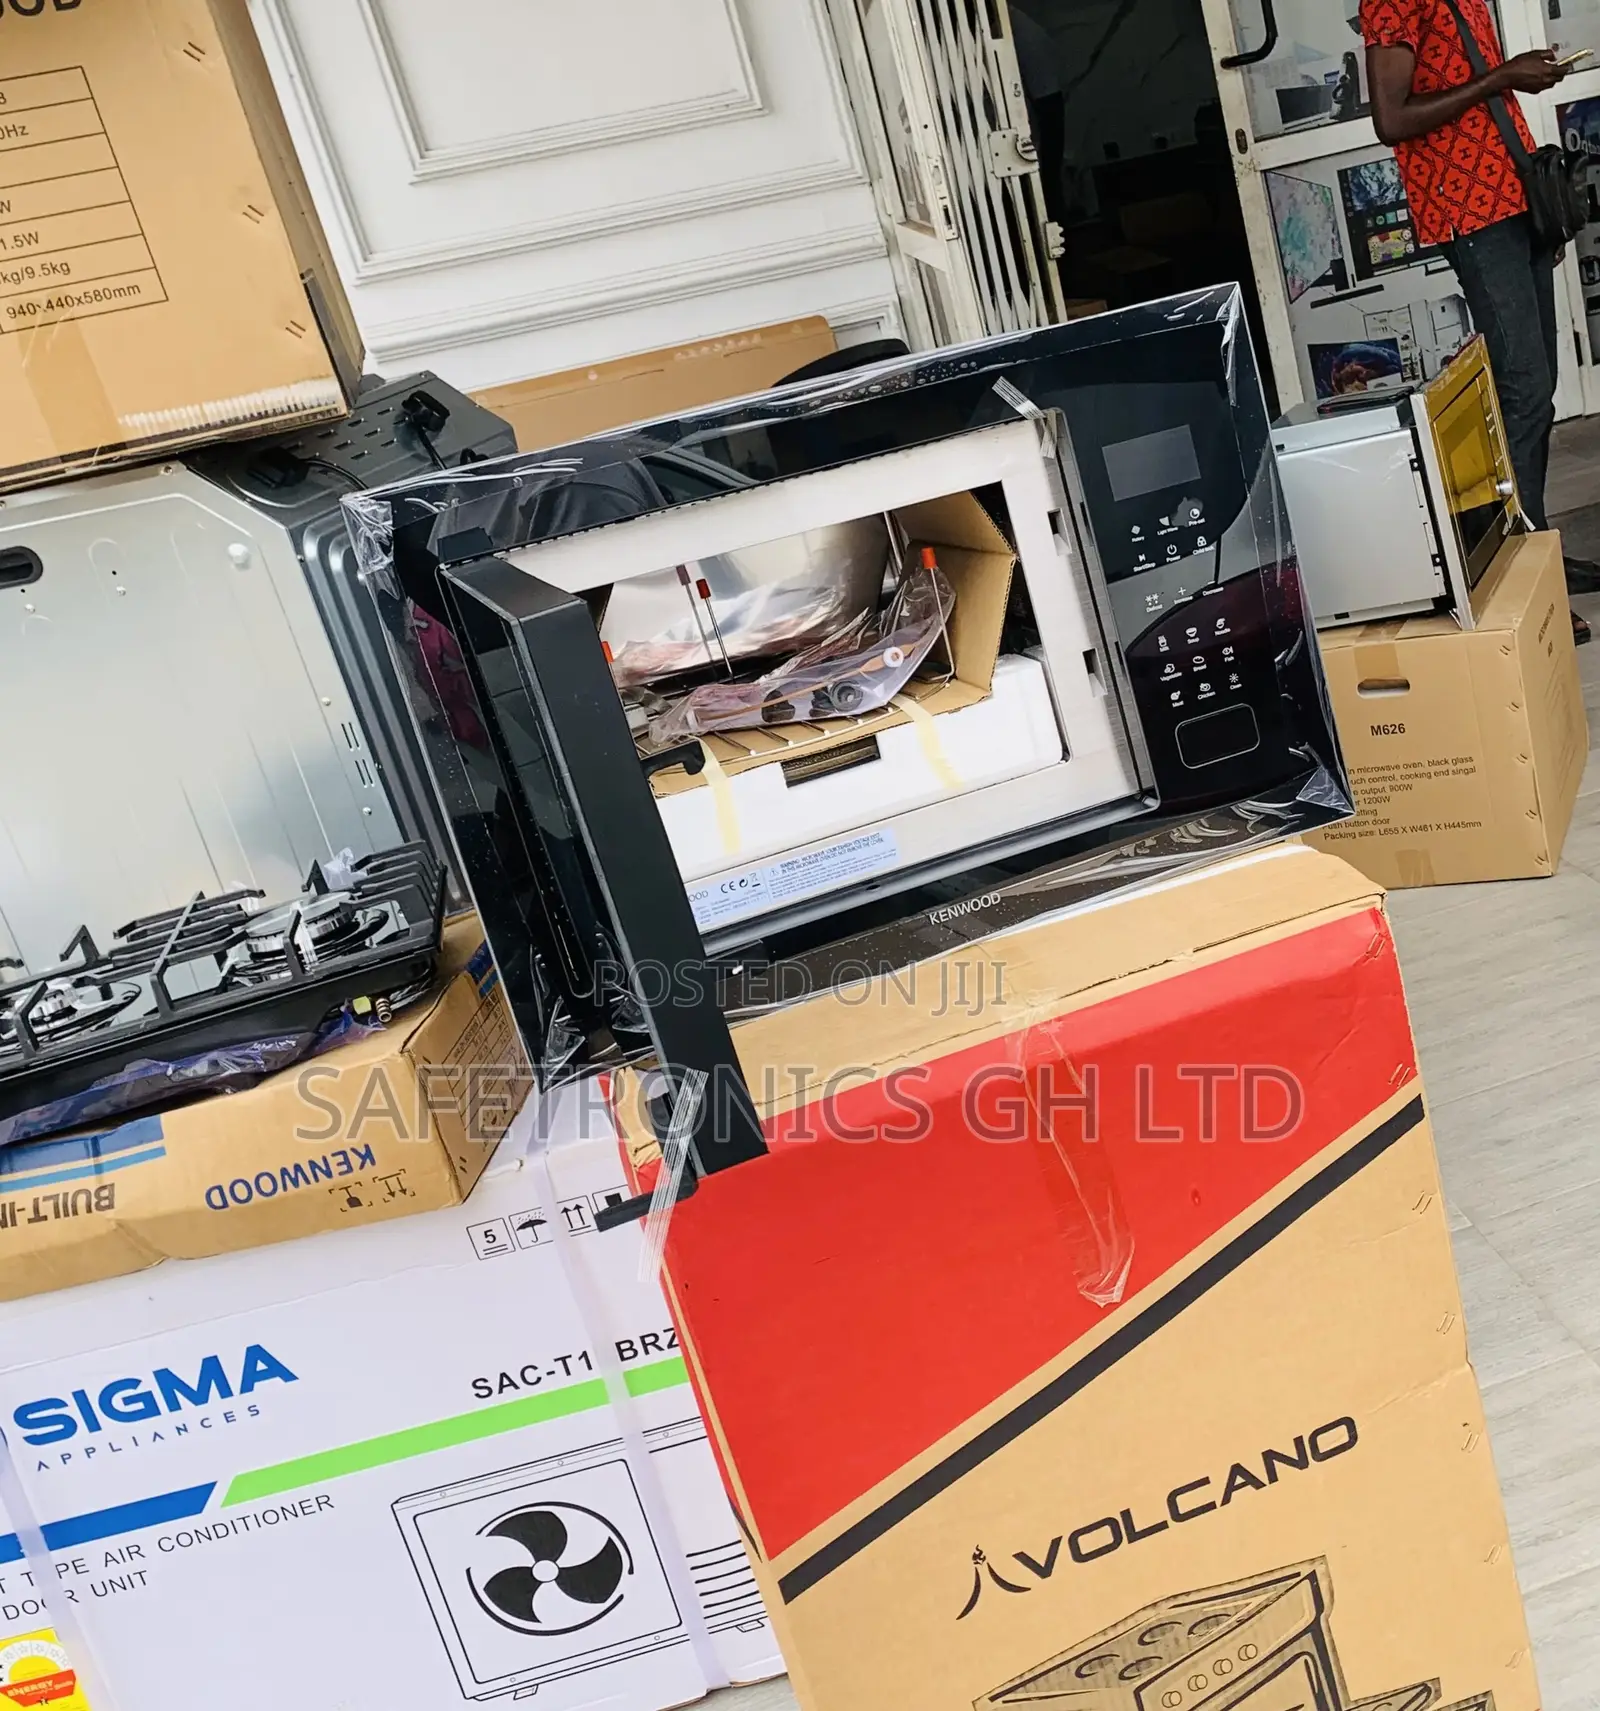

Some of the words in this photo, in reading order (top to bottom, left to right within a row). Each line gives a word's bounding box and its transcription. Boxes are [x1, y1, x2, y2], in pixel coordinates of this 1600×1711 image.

[1370, 722, 1406, 736] M626
[1356, 764, 1401, 774] microwave
[1427, 757, 1450, 767] black
[1451, 756, 1474, 767] glass
[1400, 772, 1432, 781] cooking
[1433, 769, 1450, 778] end
[1363, 796, 1391, 805] 1200W
[1323, 831, 1357, 841] Packing
[1378, 826, 1400, 836] L655
[1400, 825, 1408, 834] X
[1435, 822, 1443, 831] X
[1443, 820, 1482, 831] H445mm
[1344, 820, 1370, 828] button
[1371, 818, 1391, 826] door
[929, 893, 1001, 926] KENWOOD
[205, 1143, 377, 1211] KENWOOD
[484, 1229, 497, 1245] 5
[13, 1344, 300, 1446] SIGMA
[36, 1404, 260, 1472] APPLIANCES
[1012, 1415, 1359, 1580] VOLCANO
[20, 1557, 90, 1588] TPE
[104, 1544, 146, 1568] AIR
[157, 1494, 335, 1553] CONDITIONER
[2, 1589, 80, 1621] DOR
[90, 1570, 148, 1598] UNIT
